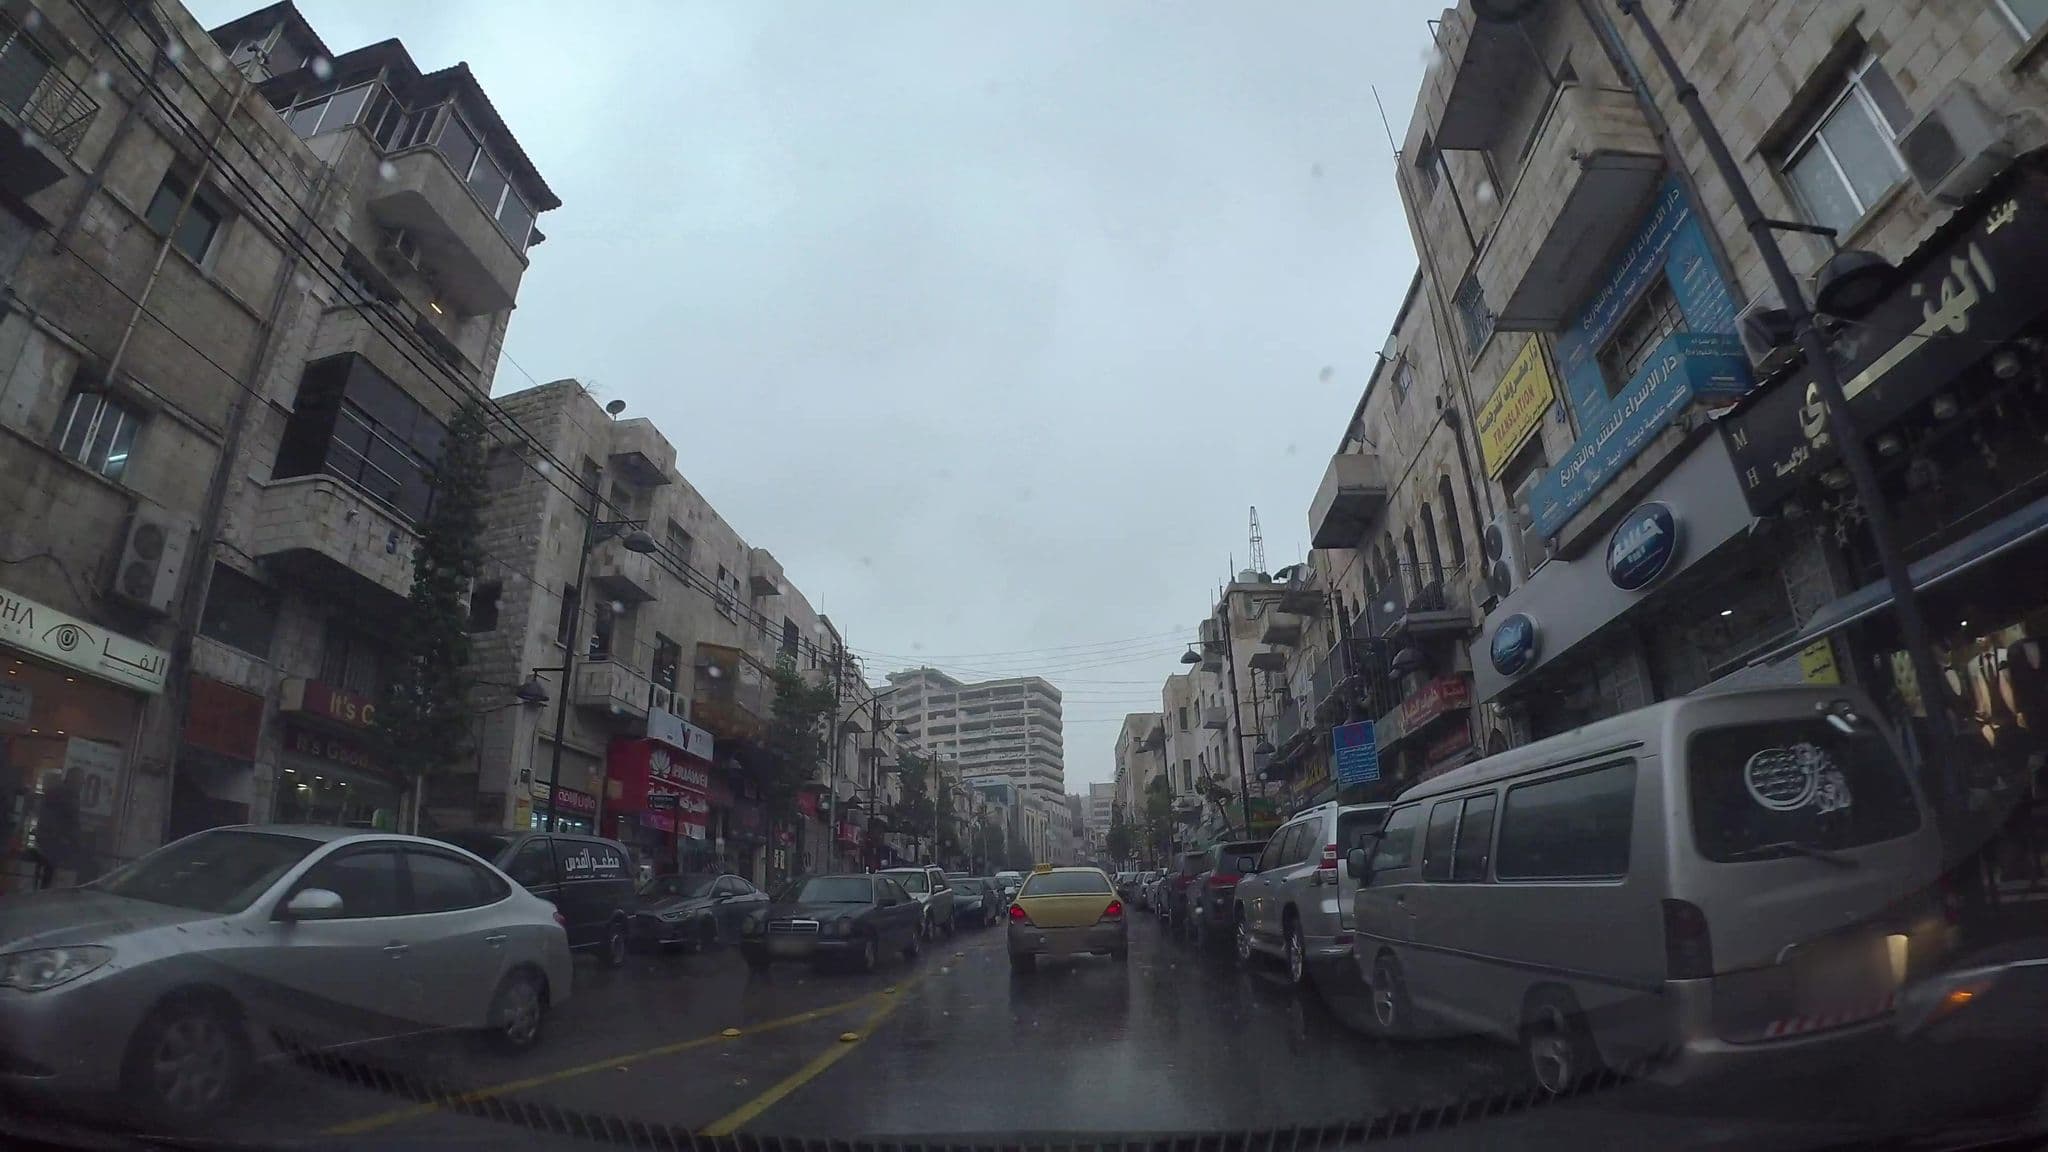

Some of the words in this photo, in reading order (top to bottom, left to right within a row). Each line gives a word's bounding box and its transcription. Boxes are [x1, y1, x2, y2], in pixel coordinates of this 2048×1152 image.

[1668, 189, 1681, 211] دار
[1662, 355, 1677, 383] دار
[1493, 383, 1536, 447] TRANSLATION
[1595, 409, 1624, 452] للنشر
[1732, 427, 1748, 451] M
[1559, 446, 1595, 488] والتوزيع
[1746, 466, 1761, 488] H
[330, 691, 356, 721] It's
[672, 764, 708, 788] HUAWEI
[565, 848, 591, 872] القدس
[592, 848, 620, 872] مطعم
